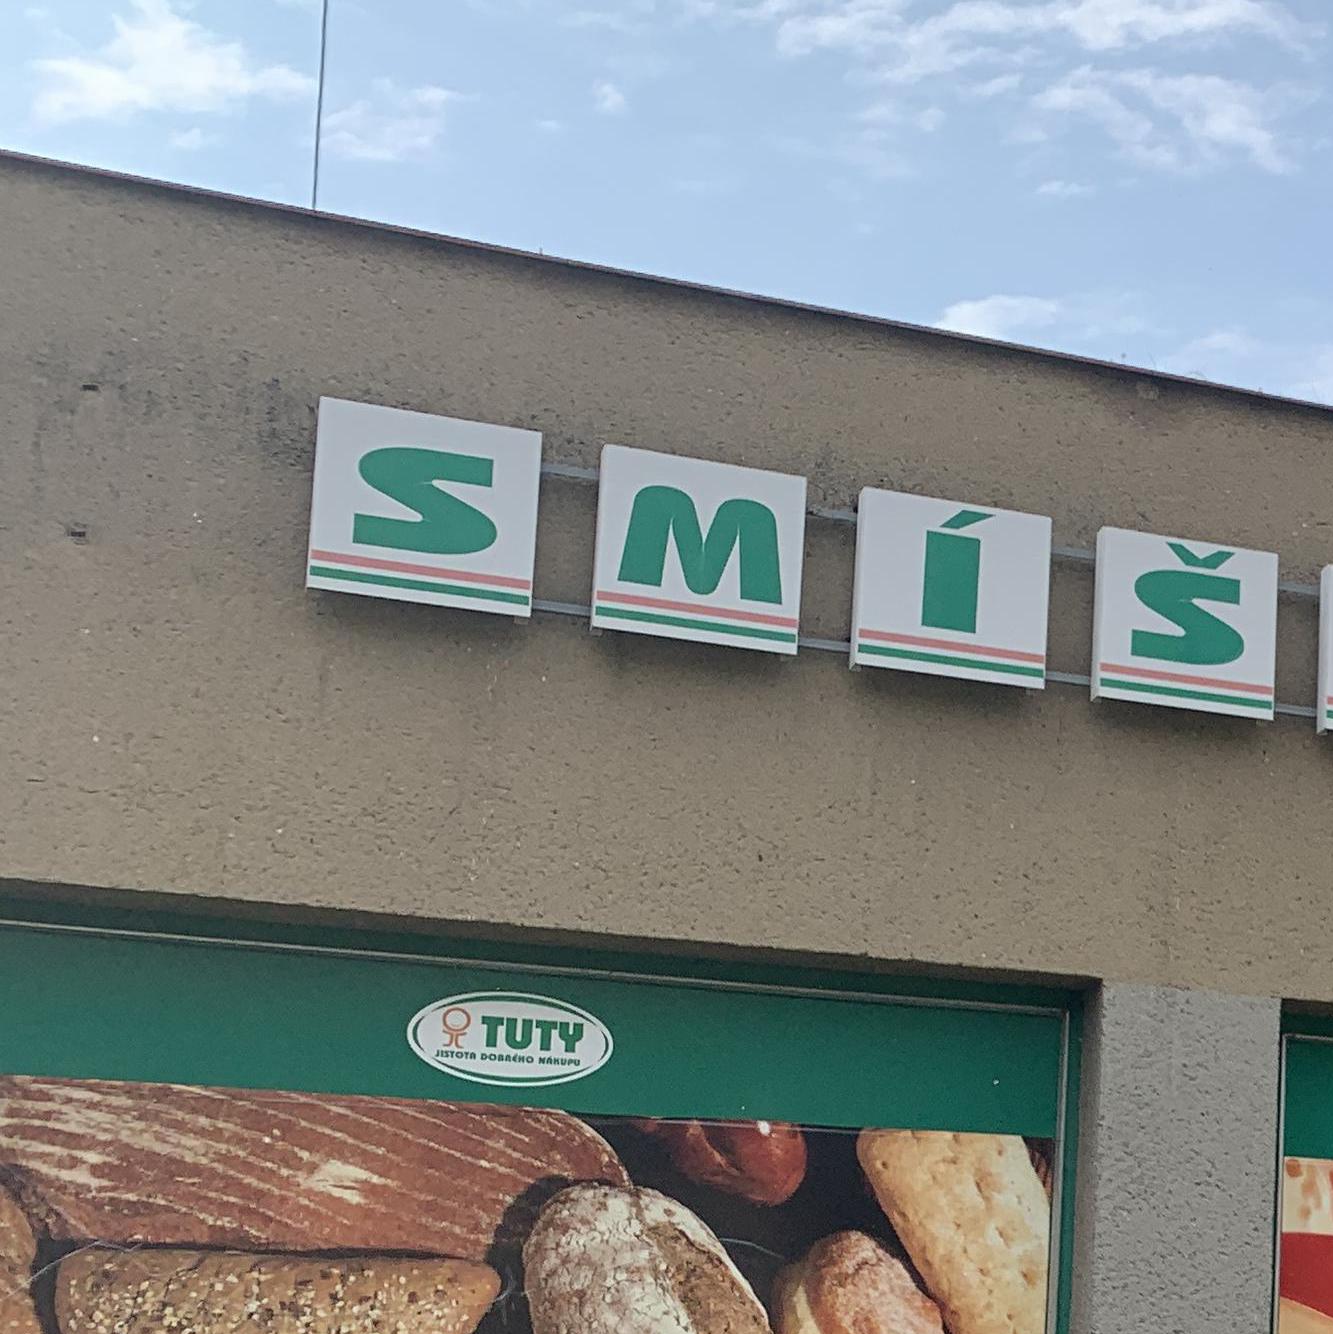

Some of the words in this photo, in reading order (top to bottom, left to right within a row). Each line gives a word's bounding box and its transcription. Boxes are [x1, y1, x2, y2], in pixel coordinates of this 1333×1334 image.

[481, 1015, 584, 1053] TUTY
[435, 1049, 477, 1060] JISTOTA
[480, 1052, 535, 1064] DOBRÉHO
[538, 1055, 581, 1067] NÁKUPU
